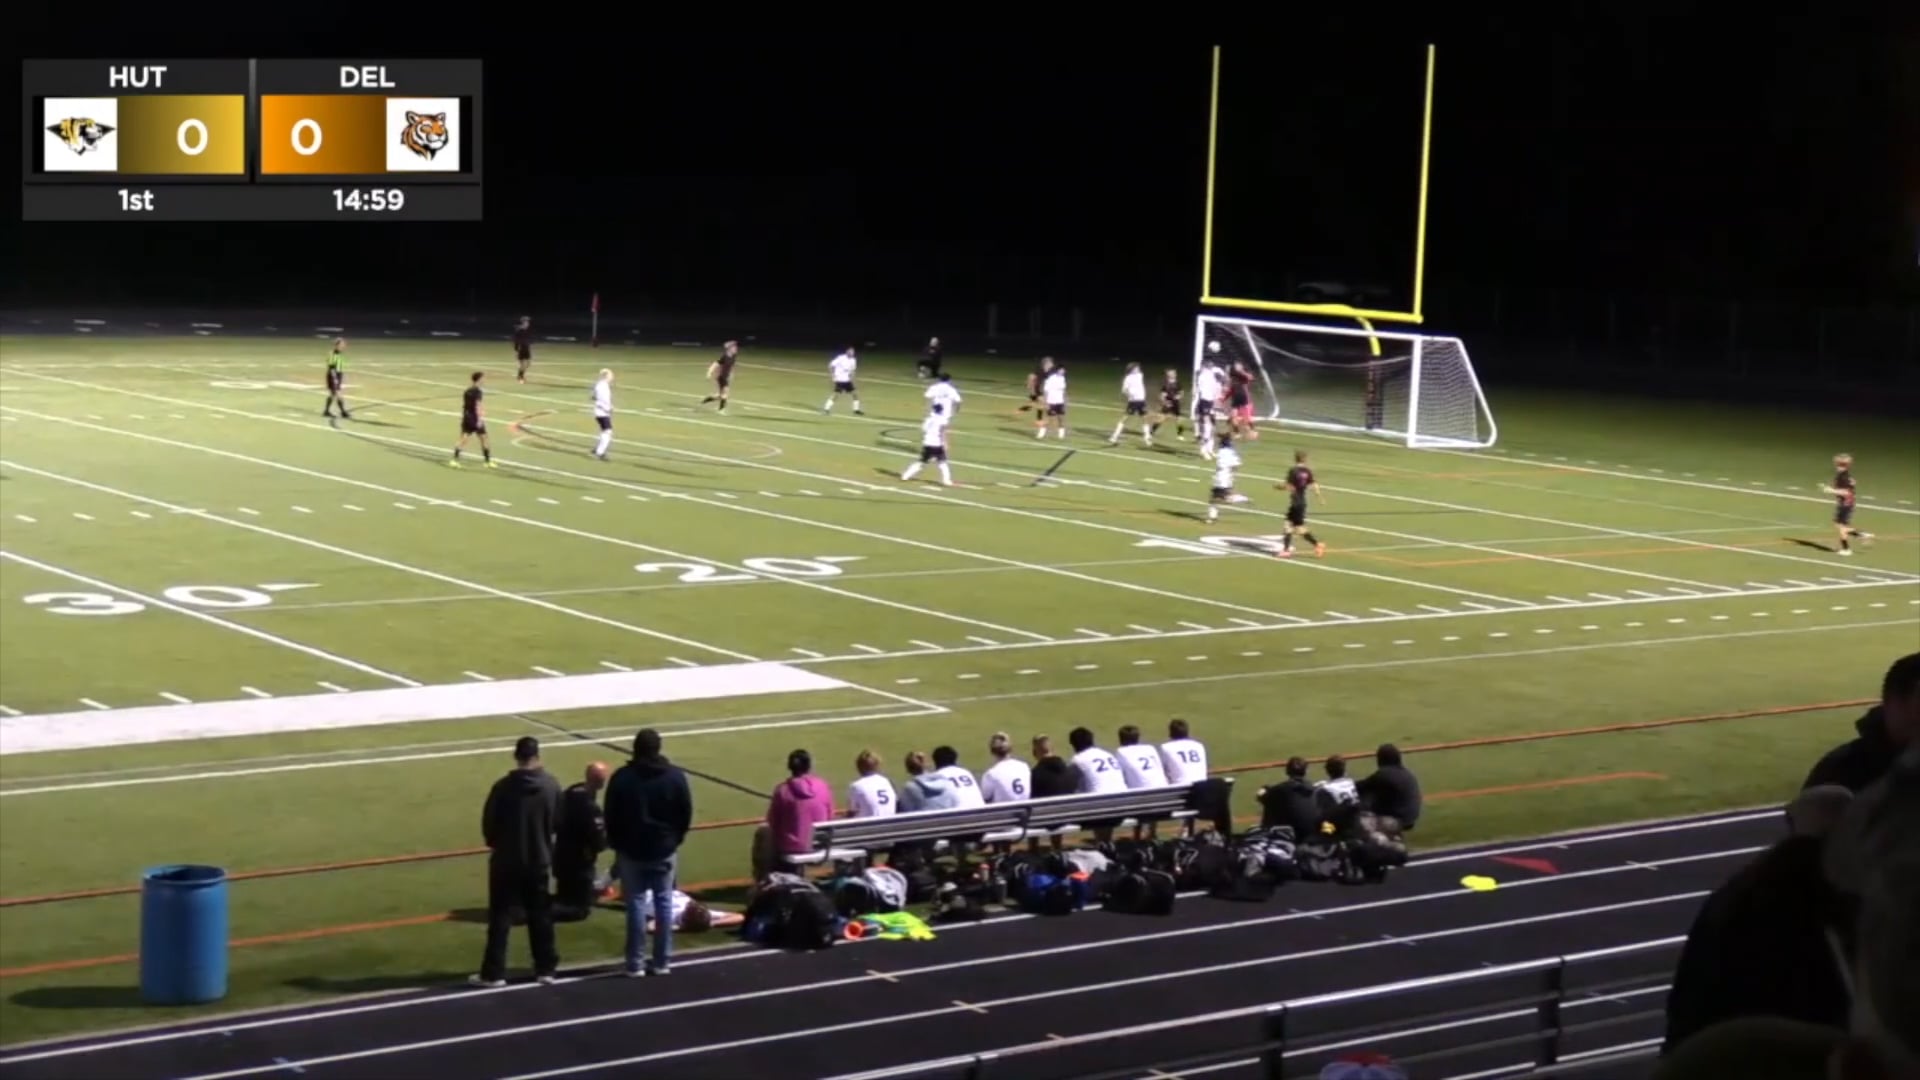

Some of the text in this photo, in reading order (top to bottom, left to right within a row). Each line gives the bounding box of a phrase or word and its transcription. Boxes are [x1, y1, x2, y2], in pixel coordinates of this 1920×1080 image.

[633, 557, 843, 583] 20
[23, 585, 273, 616] 30
[1177, 749, 1201, 764] 18
[949, 775, 973, 789] 19
[1011, 777, 1025, 795] 6
[876, 789, 890, 805] 5
